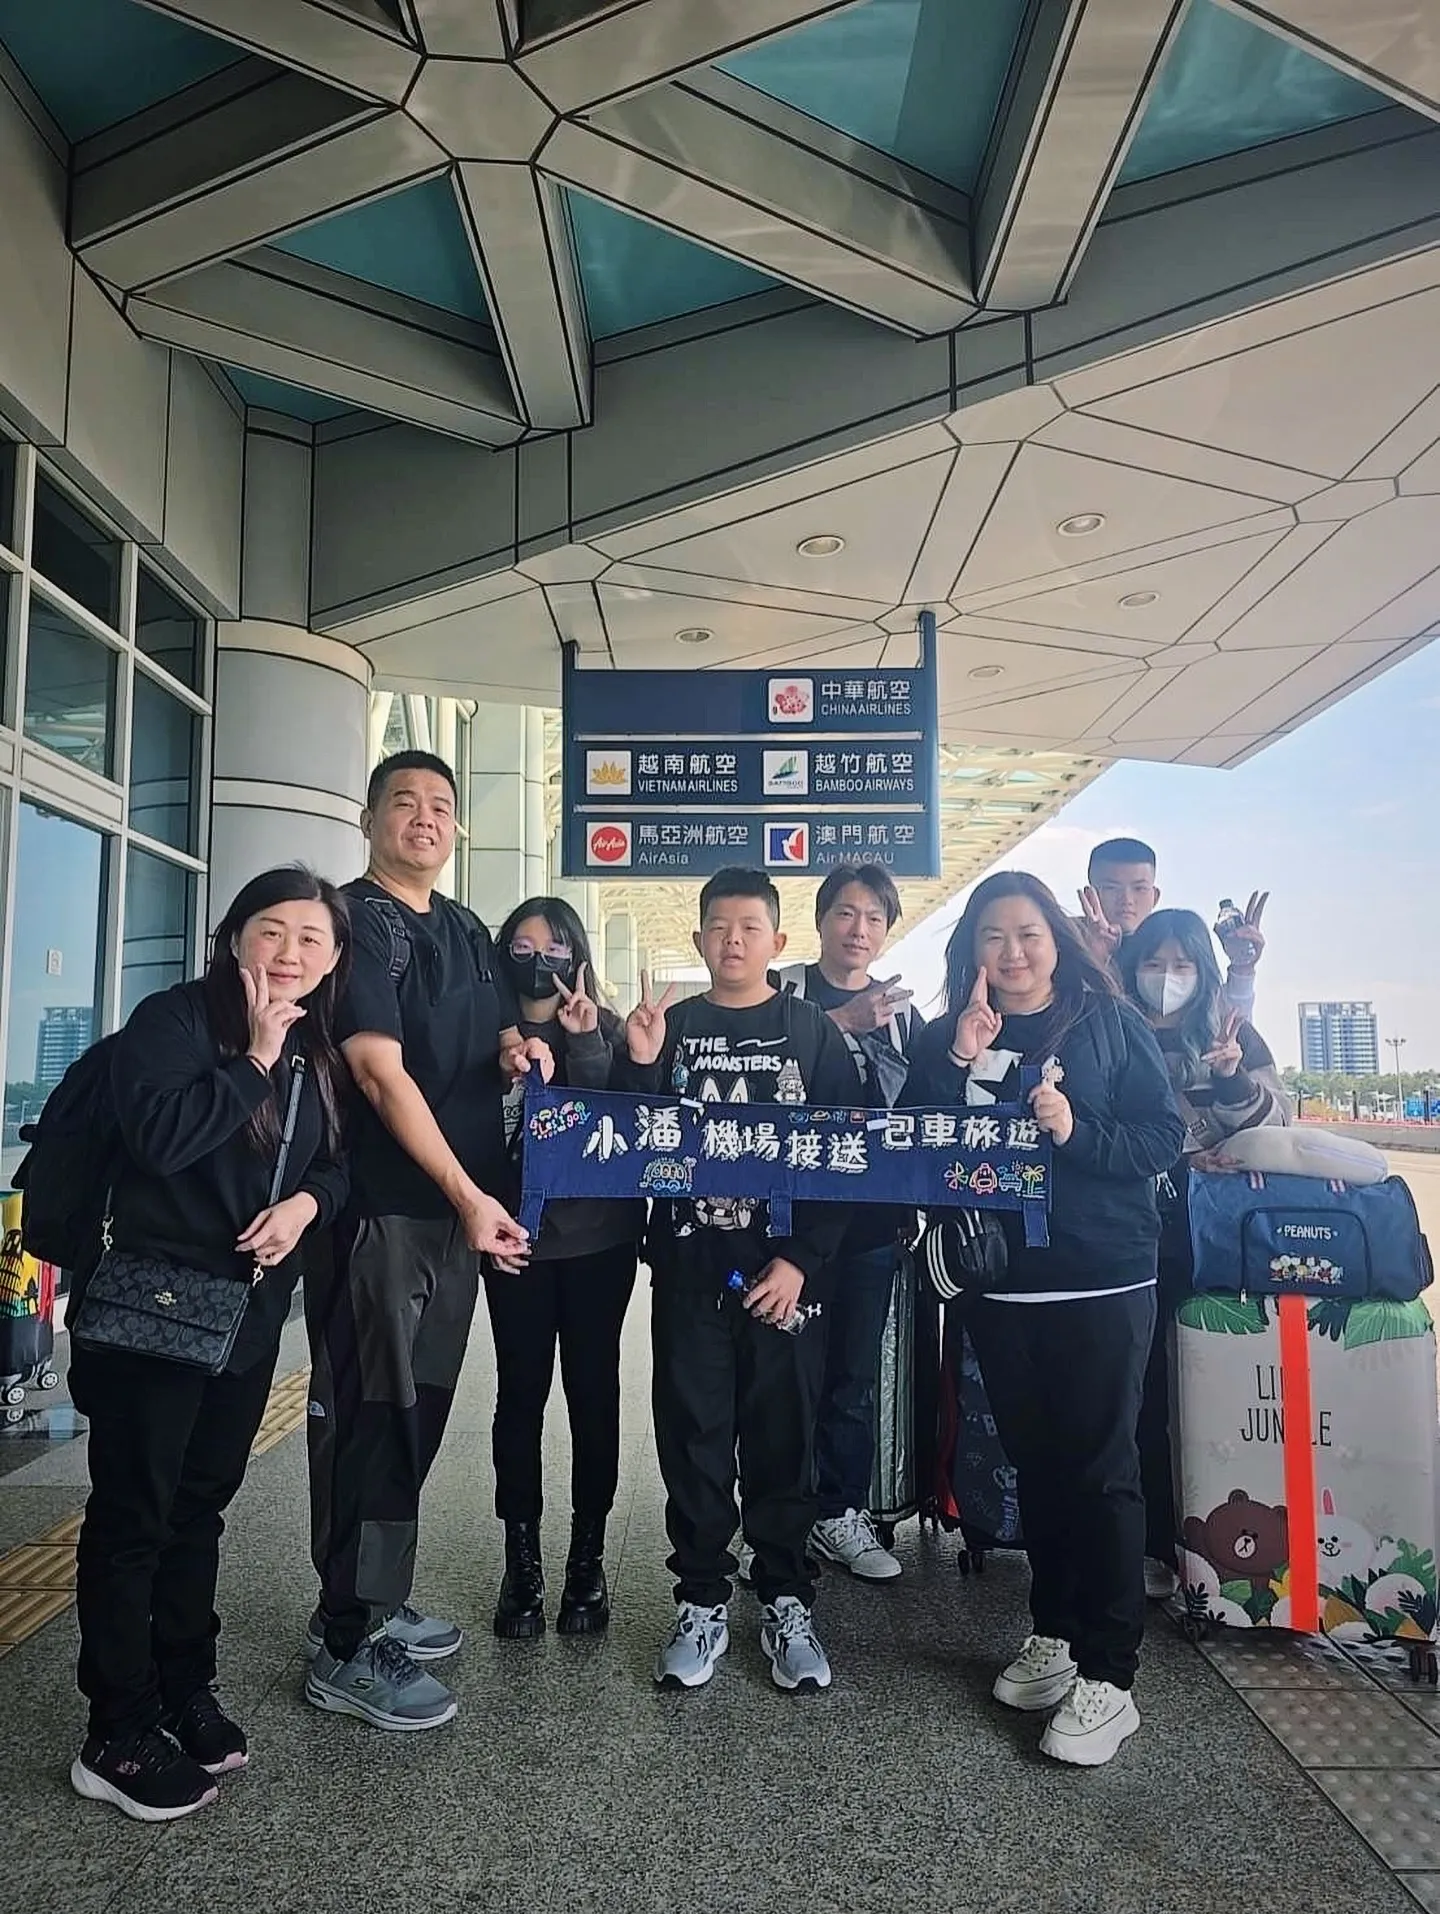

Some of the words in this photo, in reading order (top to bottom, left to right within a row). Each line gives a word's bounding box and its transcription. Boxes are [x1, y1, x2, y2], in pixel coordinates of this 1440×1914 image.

[821, 680, 911, 701] 中華航空
[638, 753, 737, 775] 越南航空
[814, 753, 914, 775] 越竹航空
[638, 825, 749, 846] 馬亞洲航空
[815, 825, 916, 846] 澳門航空
[638, 851, 689, 865] AirAsia
[815, 852, 836, 864] Air
[683, 1036, 730, 1055] THE
[690, 1053, 782, 1072] MONSTERS
[582, 1104, 682, 1163] 小潘
[700, 1118, 869, 1174] 機場接送
[882, 1111, 1041, 1151] 包車旅遊
[1284, 1224, 1333, 1241] PEANUTS
[1240, 1407, 1332, 1447] JUNE
